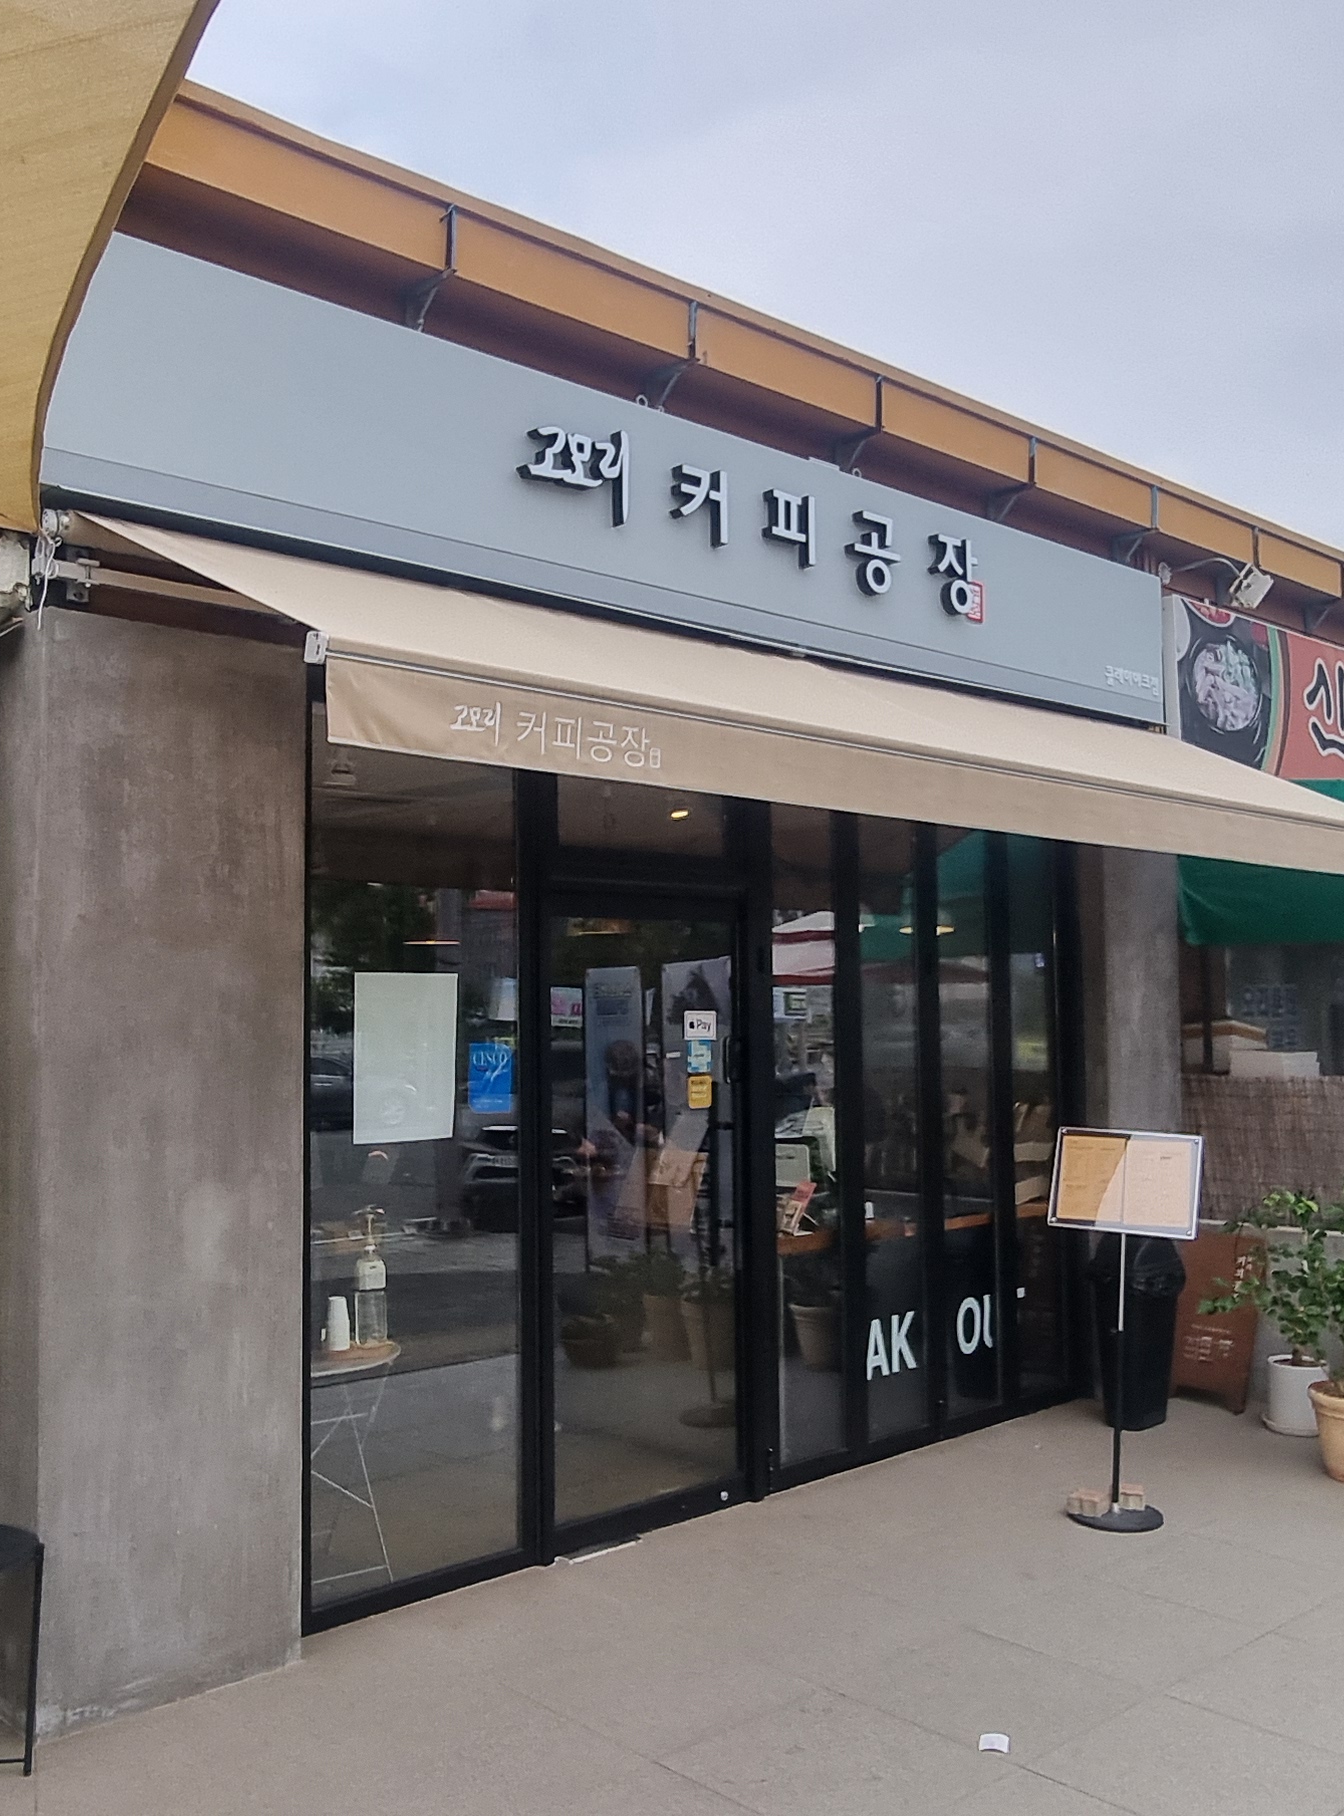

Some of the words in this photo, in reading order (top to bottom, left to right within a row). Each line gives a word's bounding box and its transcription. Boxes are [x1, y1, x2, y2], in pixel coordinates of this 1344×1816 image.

[516, 426, 629, 528] 고모리
[669, 463, 978, 617] 커피공장
[449, 701, 502, 747] 고모리
[516, 710, 652, 768] 커피공장
[696, 1018, 712, 1032] Pay
